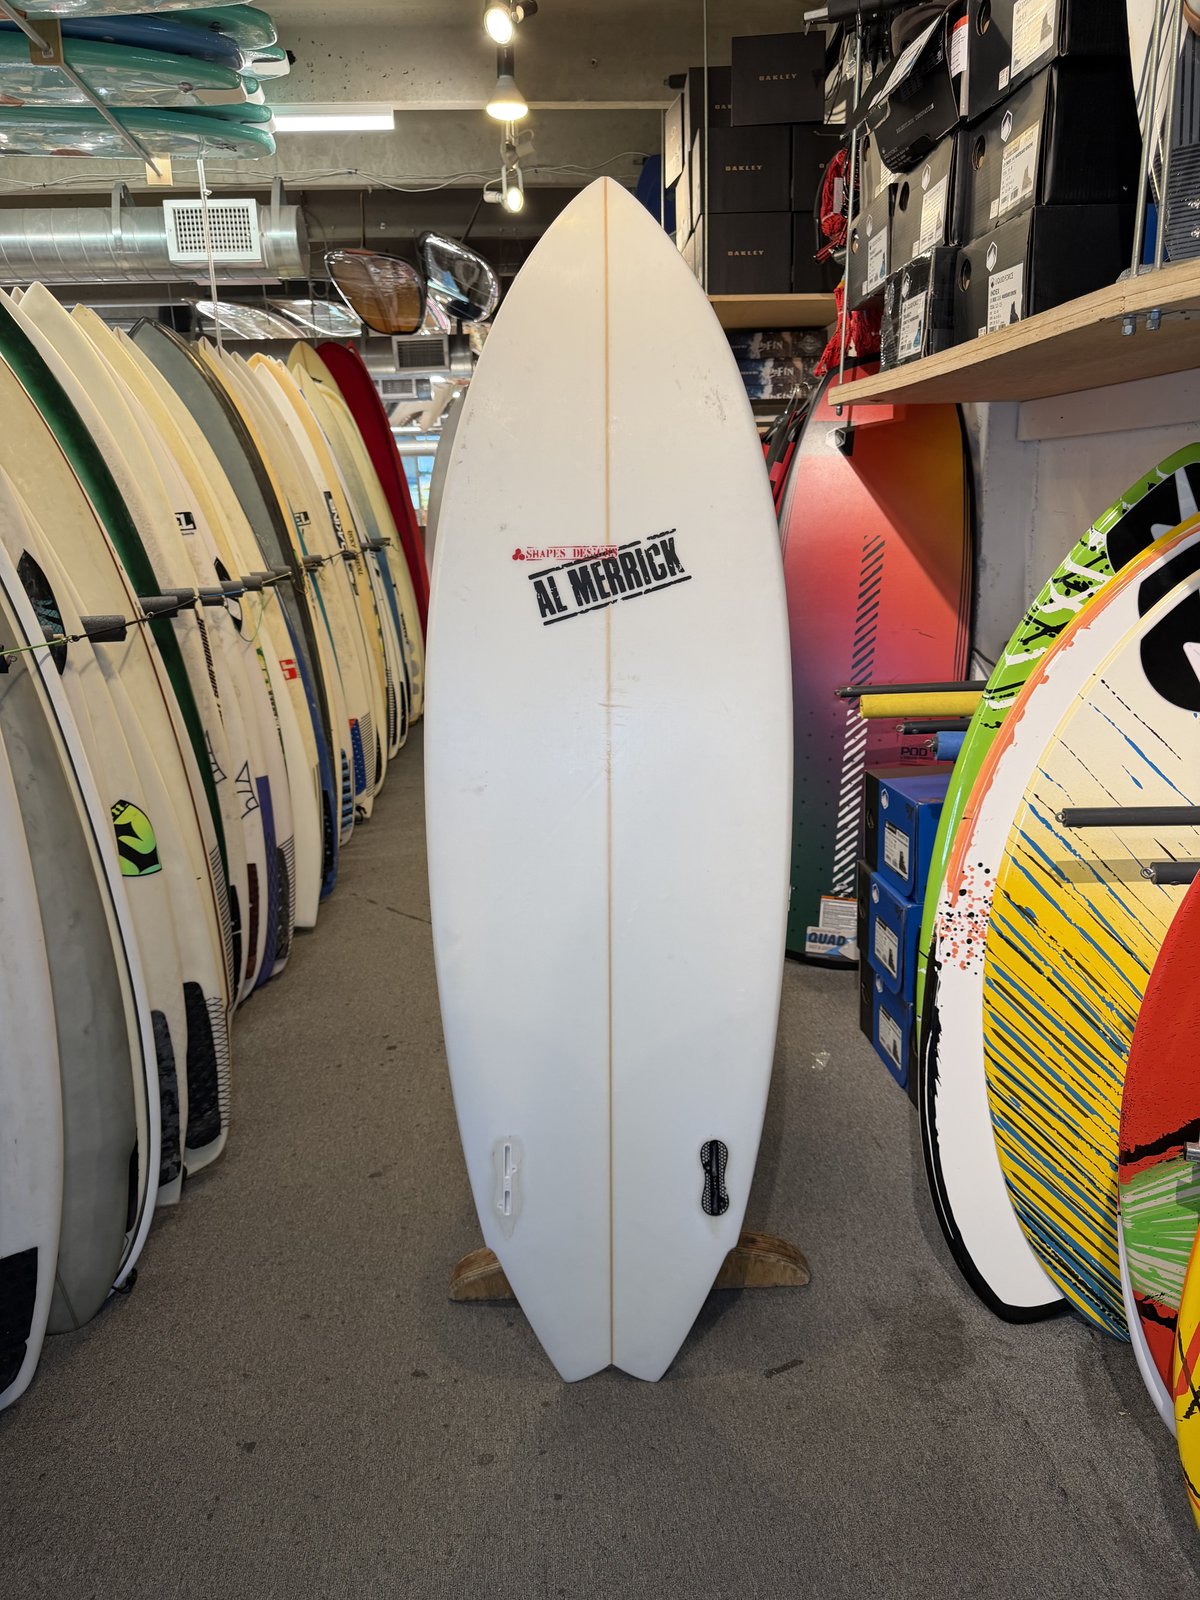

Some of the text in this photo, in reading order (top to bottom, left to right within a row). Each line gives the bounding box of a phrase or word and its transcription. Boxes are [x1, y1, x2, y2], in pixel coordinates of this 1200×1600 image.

[759, 73, 797, 81] OAKLEY
[526, 548, 566, 559] SHAPES
[534, 537, 685, 618] AL MERRICK
[900, 746, 928, 757] POD
[808, 931, 847, 946] QUAD
